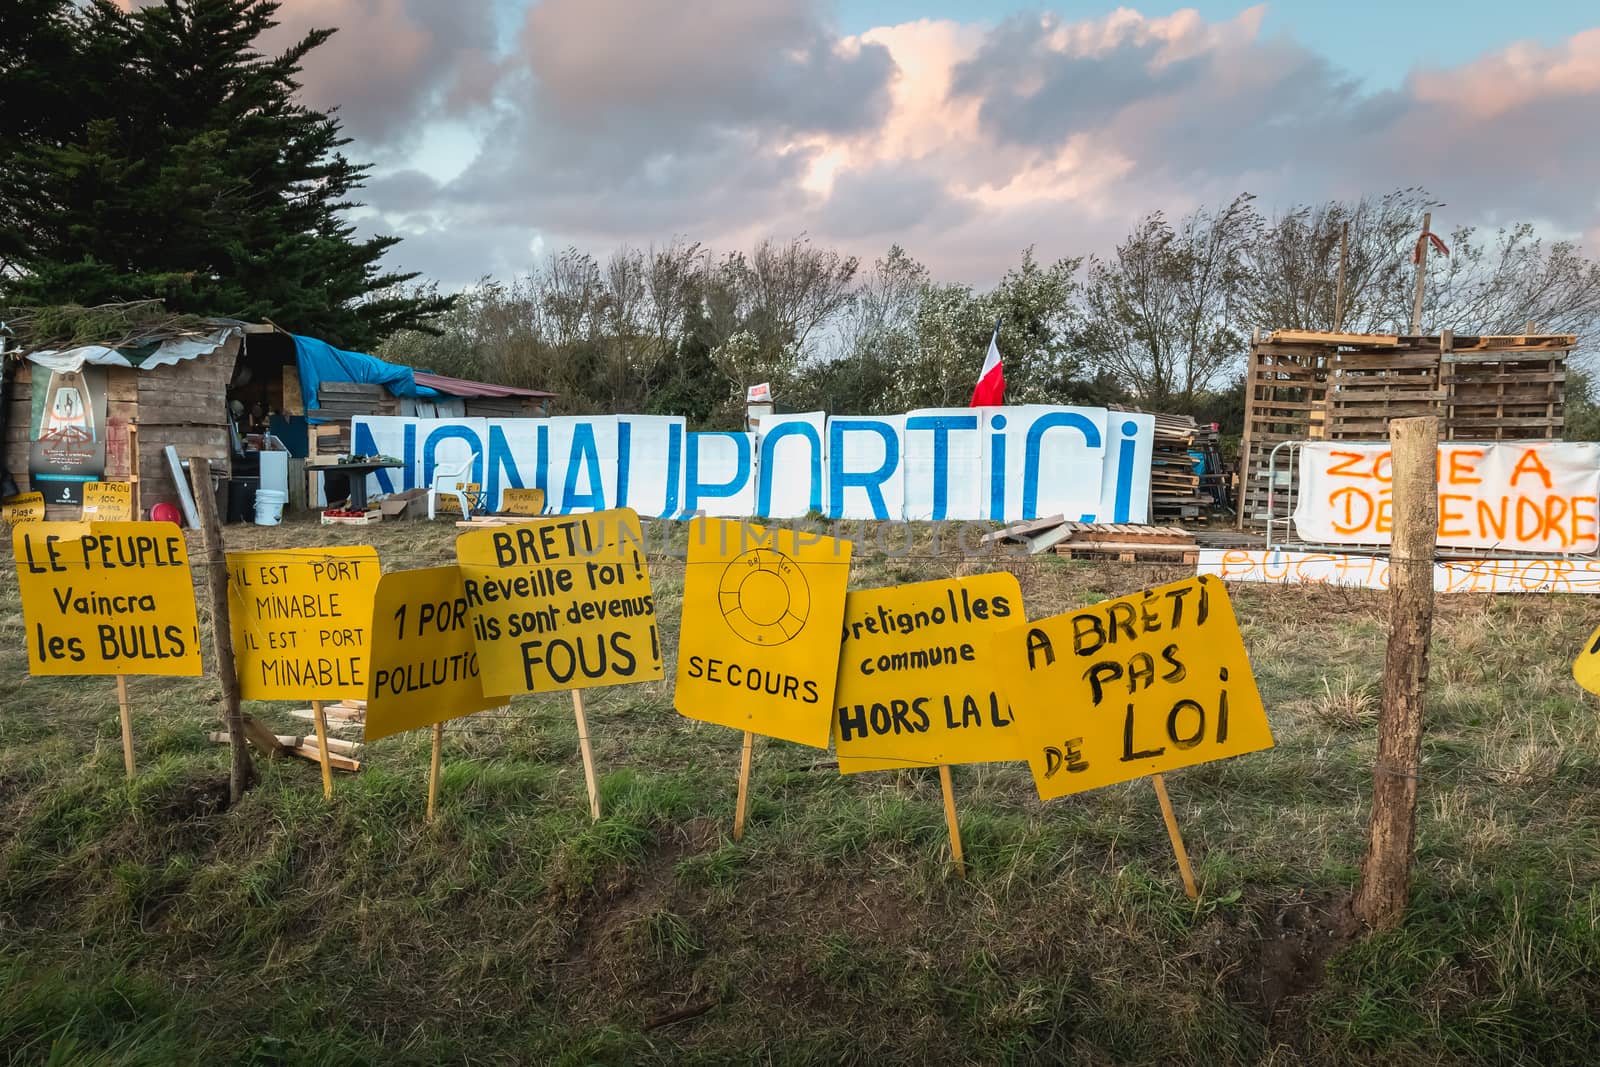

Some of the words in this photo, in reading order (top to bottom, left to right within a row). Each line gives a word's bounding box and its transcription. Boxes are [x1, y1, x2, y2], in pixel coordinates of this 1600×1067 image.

[103, 482, 130, 493] TROU
[1326, 449, 1485, 485] ZOE
[1509, 449, 1553, 489] A
[24, 534, 67, 573] LE
[80, 535, 183, 570] PEUPLE
[260, 565, 288, 585] EST
[313, 560, 361, 583] PORT
[53, 587, 156, 616] Vaincra
[394, 604, 407, 640] 1
[418, 597, 468, 636] POR
[472, 613, 500, 641] ils
[508, 604, 560, 638] sont
[566, 594, 655, 625] devenus
[37, 622, 86, 663] les
[98, 624, 186, 660] BULLS
[269, 630, 297, 649] EST
[319, 629, 363, 647] PORT
[860, 643, 976, 675] commune
[1026, 628, 1055, 671] A
[520, 631, 637, 690] FOUS
[687, 655, 819, 704] SECOURS
[1082, 643, 1187, 707] PAS
[838, 697, 930, 742] HORS
[944, 694, 981, 729] LA
[1043, 737, 1090, 779] DE
